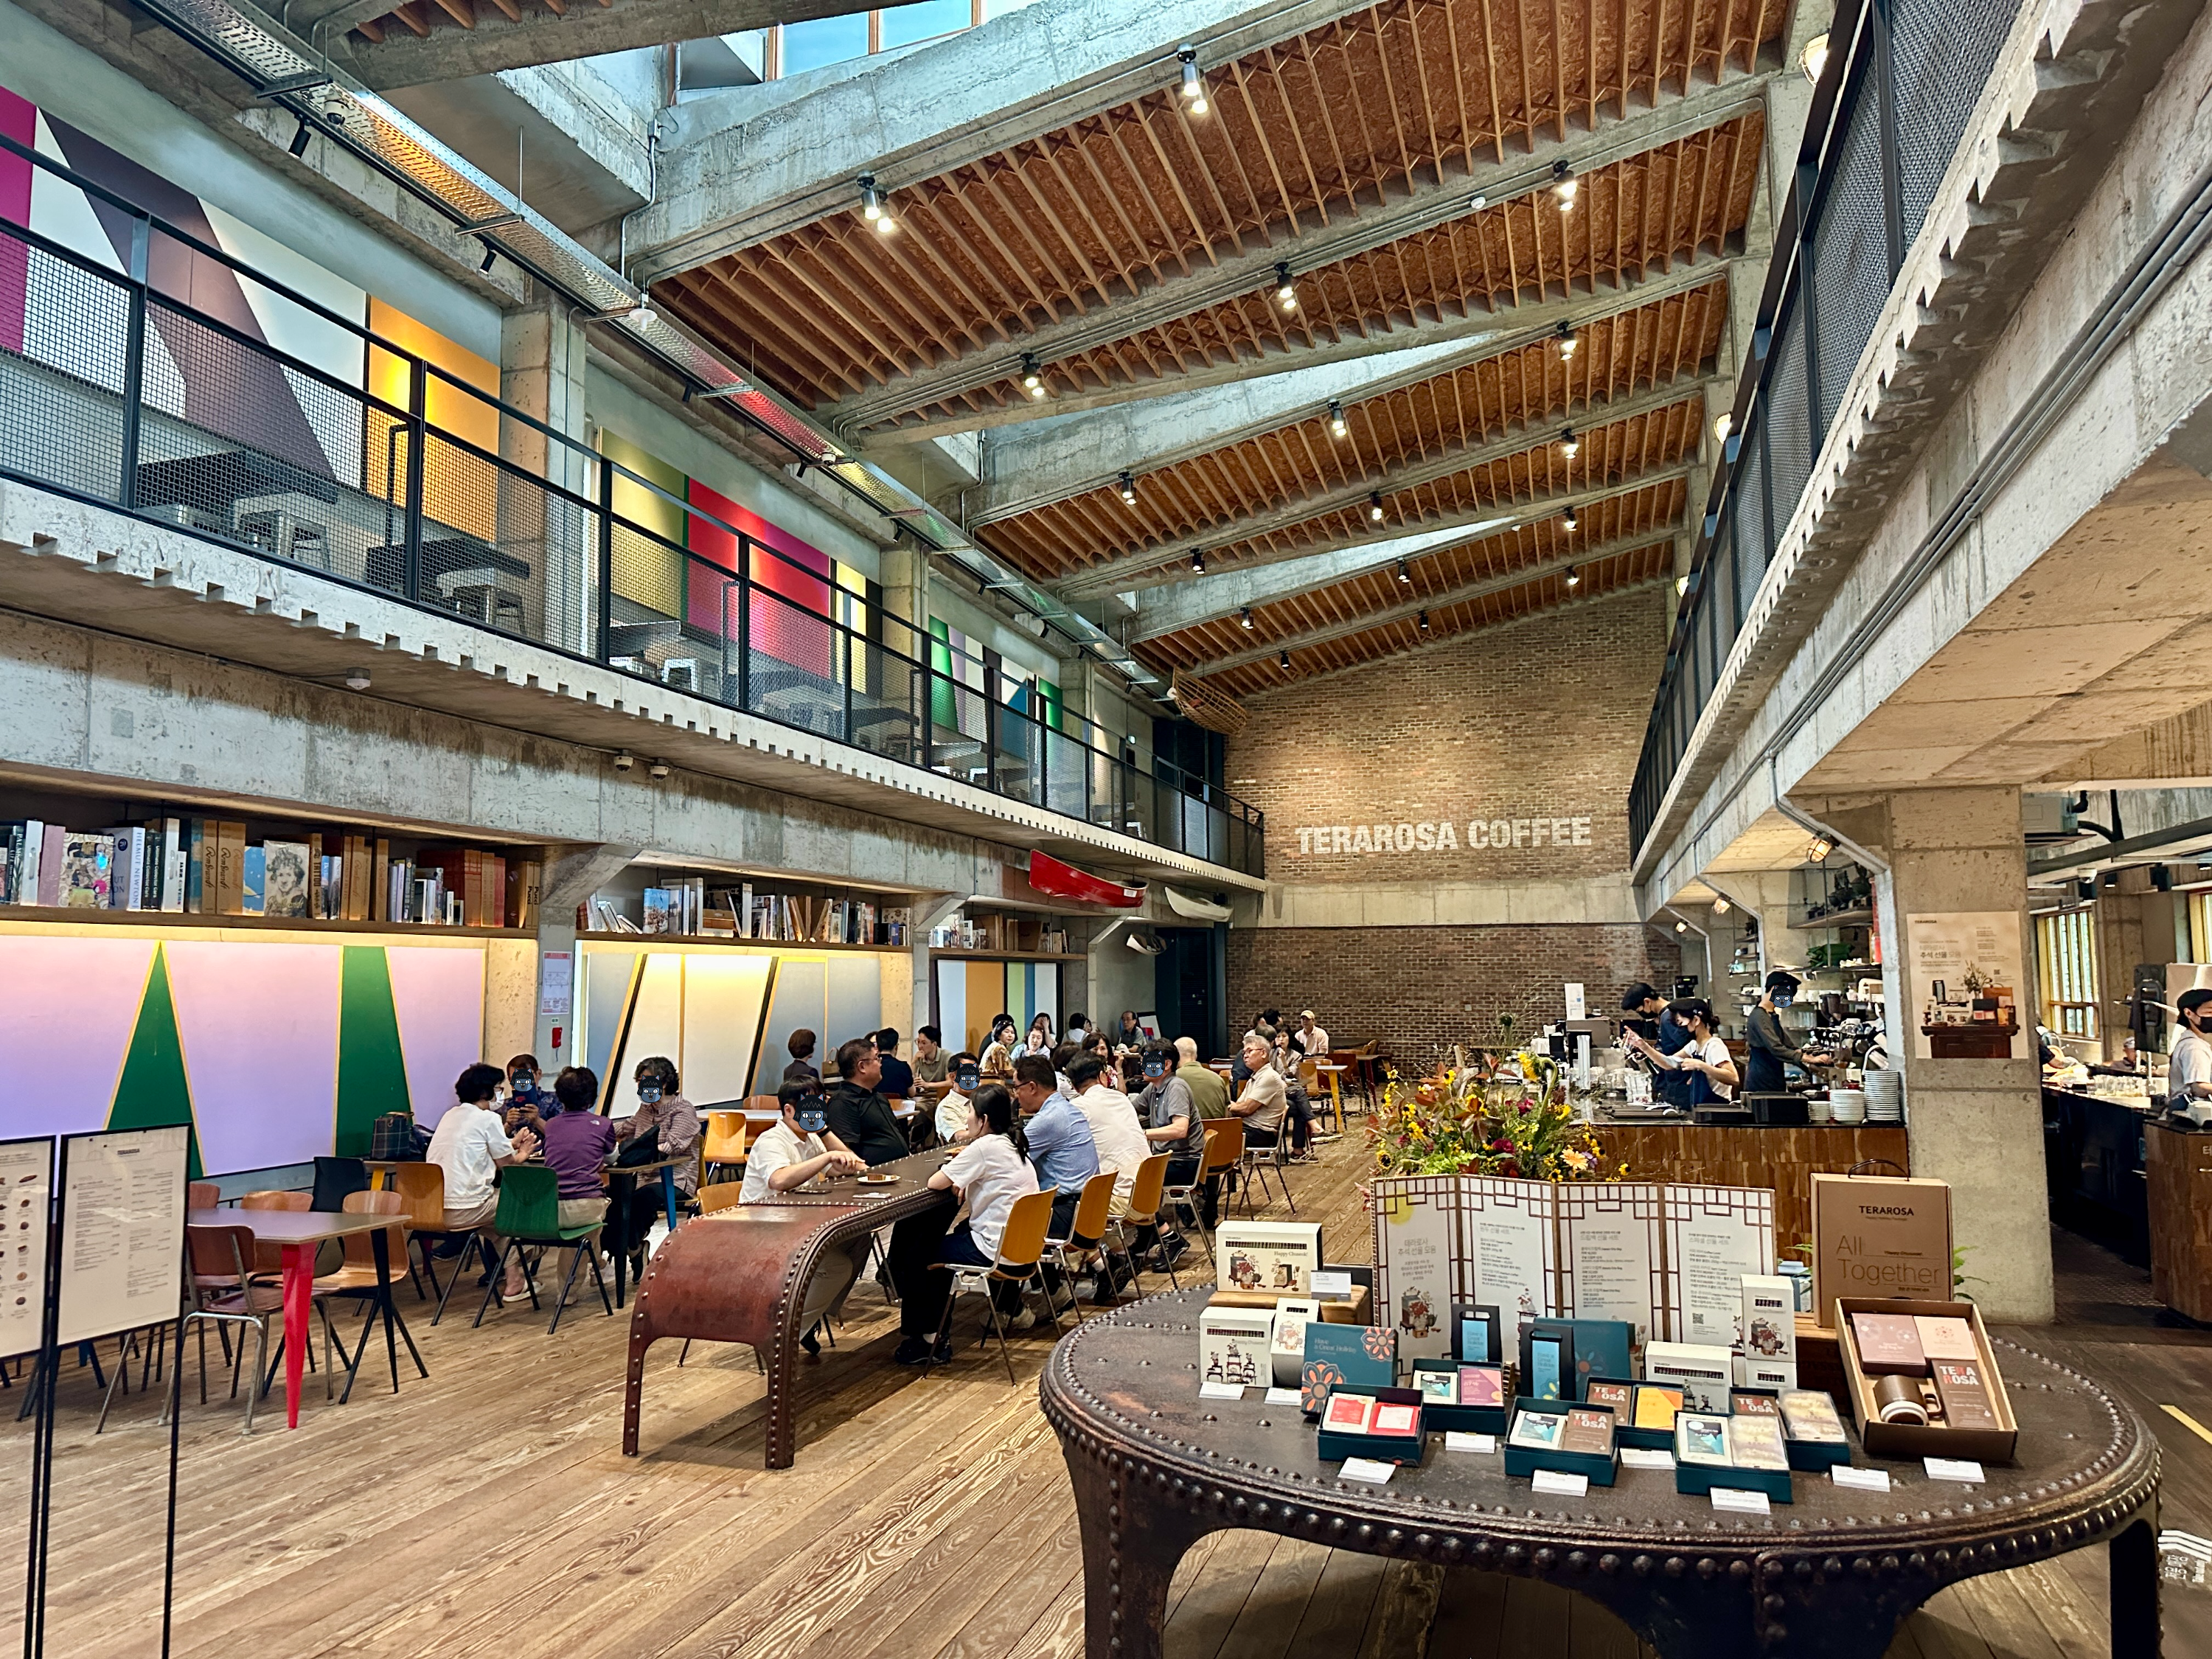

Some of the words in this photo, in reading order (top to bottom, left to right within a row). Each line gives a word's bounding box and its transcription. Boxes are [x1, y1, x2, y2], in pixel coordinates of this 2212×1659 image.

[1295, 821, 1458, 854] TERAROSA
[1467, 816, 1592, 849] COFFEE
[1859, 1206, 1914, 1216] TERAROSA
[1404, 1238, 1428, 1247] 테라로사
[1836, 1235, 1862, 1256] All
[1398, 1248, 1410, 1256] 추석
[1411, 1246, 1423, 1255] 선물
[1837, 1258, 1941, 1286] Together
[1939, 1366, 1976, 1376] TERA
[1942, 1374, 1980, 1385] ROSA
[1593, 1386, 1626, 1396] TERA
[1593, 1392, 1625, 1402] ROSA
[1737, 1397, 1773, 1407] TERA
[1740, 1404, 1775, 1413] ROSA
[1573, 1413, 1607, 1423] TERA
[1573, 1419, 1607, 1429] ROSA
